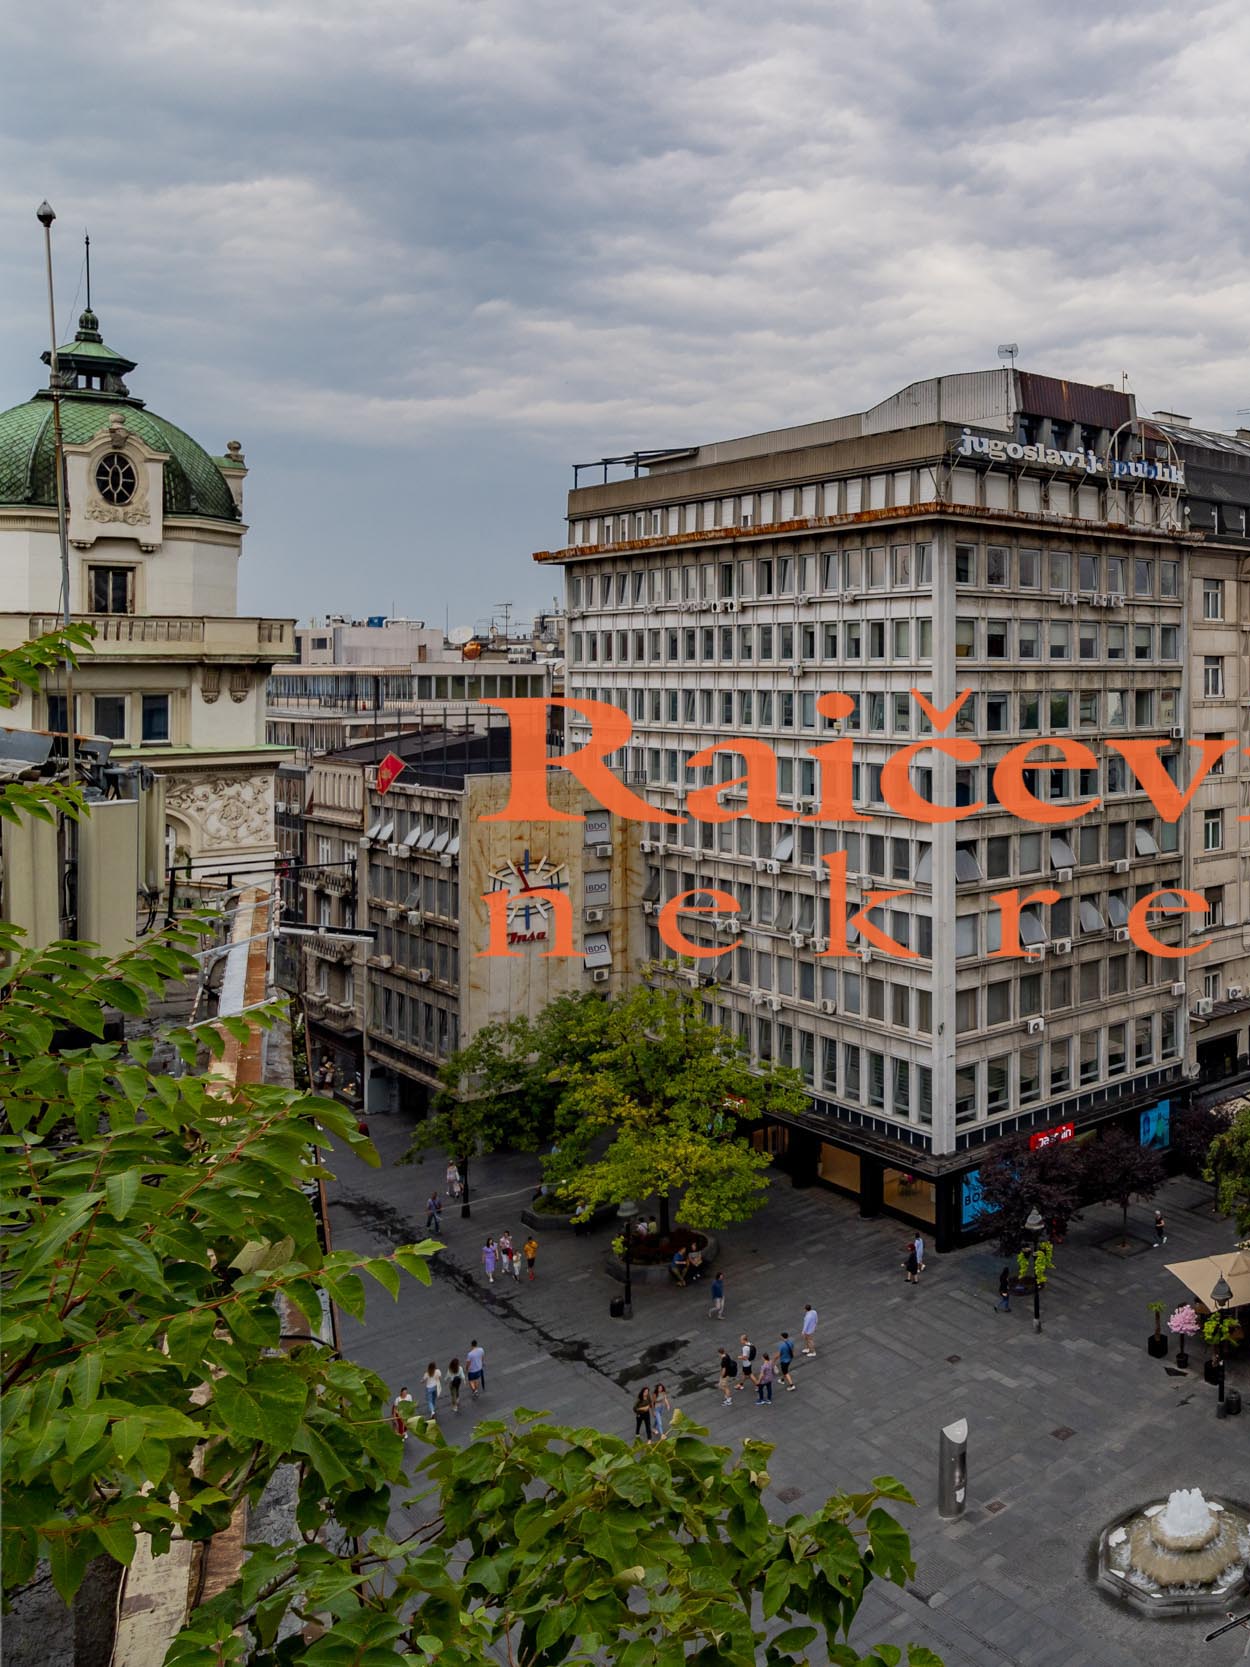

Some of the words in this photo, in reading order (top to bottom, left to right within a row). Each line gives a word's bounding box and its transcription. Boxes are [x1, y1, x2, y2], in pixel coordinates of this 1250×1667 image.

[587, 822, 607, 832] BDO
[587, 882, 607, 893] BDO
[507, 930, 547, 945] Insa
[587, 943, 607, 954] BDO
